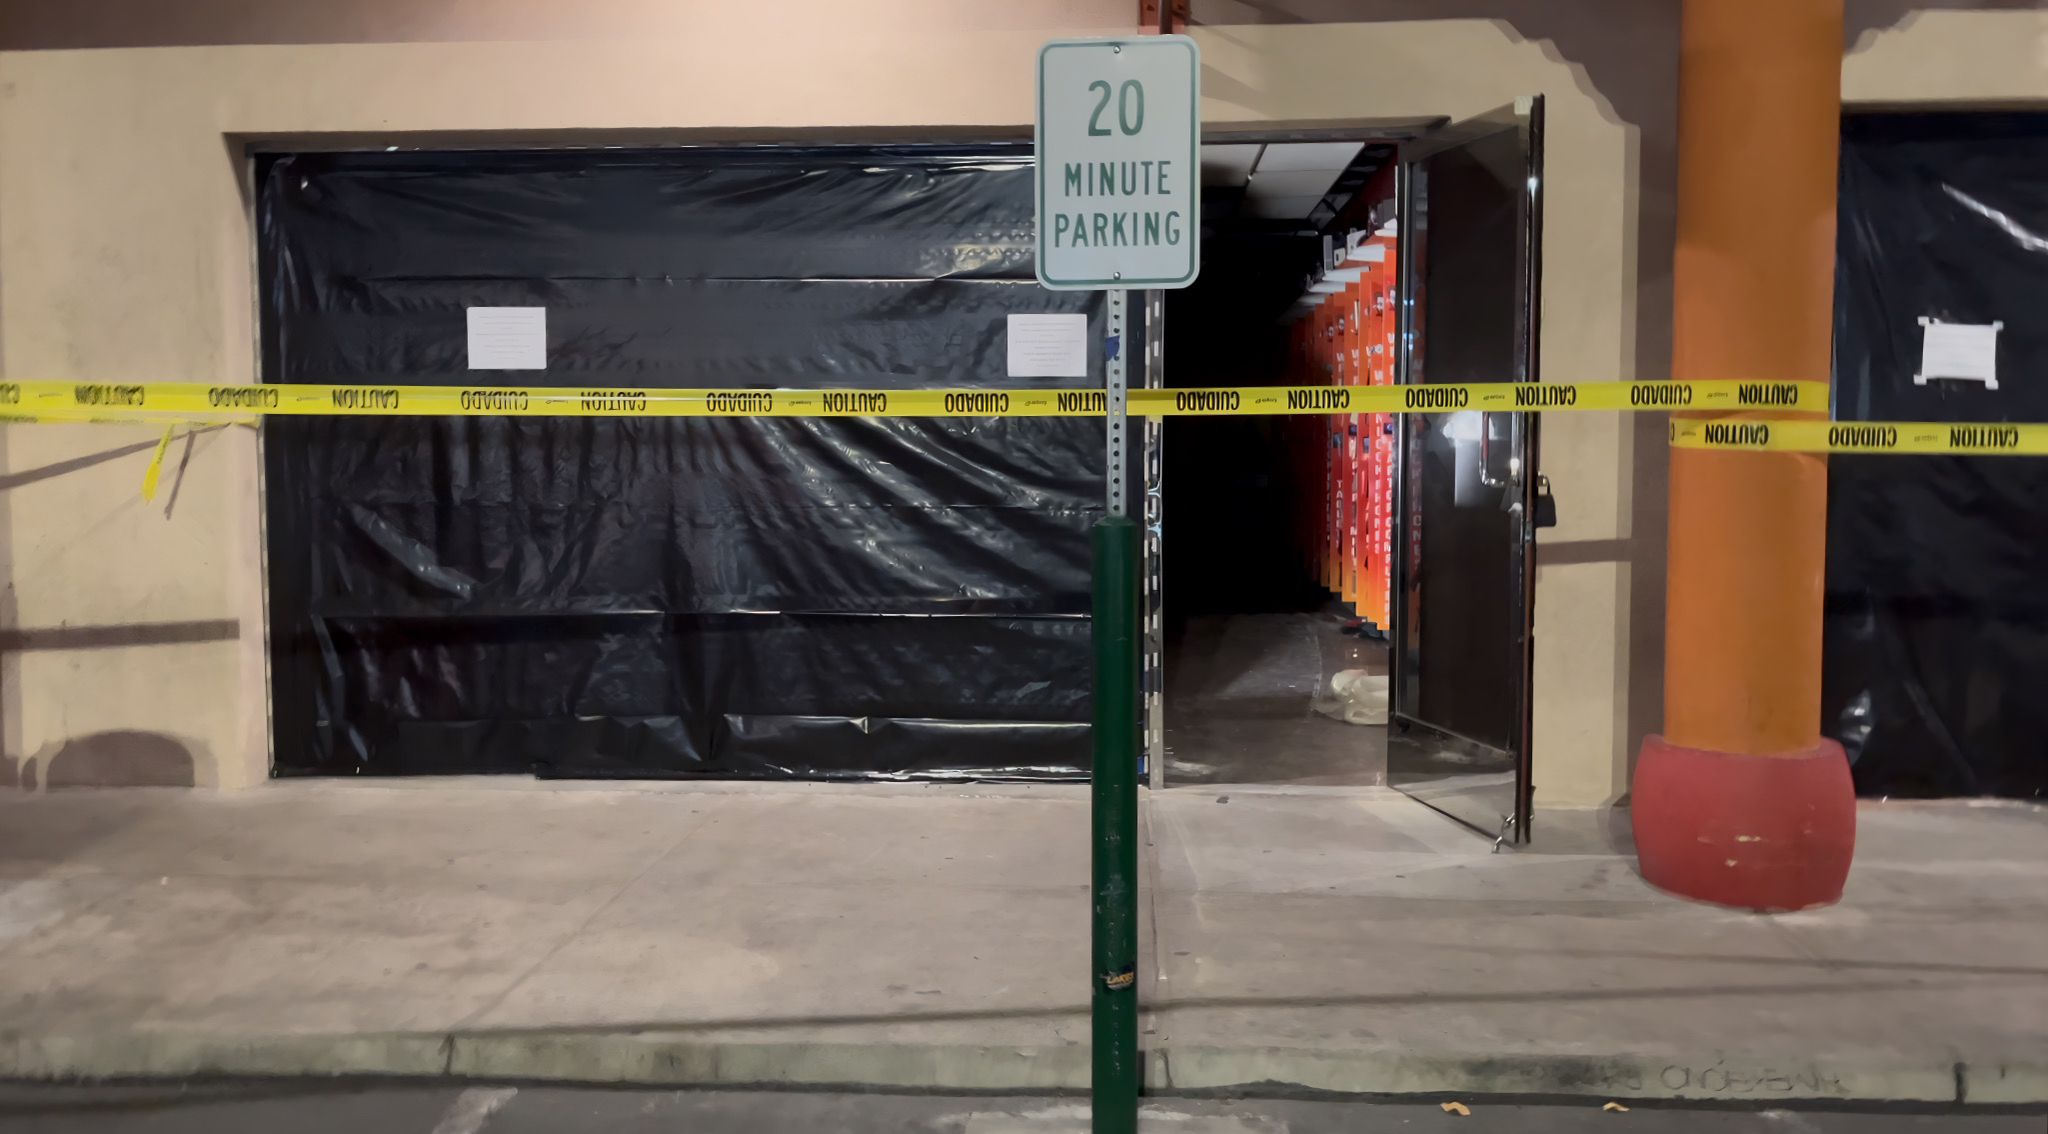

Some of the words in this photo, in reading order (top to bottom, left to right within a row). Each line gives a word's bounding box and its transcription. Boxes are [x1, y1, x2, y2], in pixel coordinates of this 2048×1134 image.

[1088, 79, 1145, 136] 20
[1065, 161, 1171, 196] MINUTE
[1055, 211, 1180, 247] PARKING
[208, 387, 279, 408] CUIDADO
[331, 388, 400, 409] CAUTION
[460, 390, 529, 411] CUIDADO
[580, 391, 647, 411] CAUTION
[706, 392, 773, 412] CUIDADO
[822, 392, 887, 413] CAUTION
[944, 392, 1010, 413] CUIDADO
[1057, 391, 1107, 412] AUTION
[1175, 390, 1240, 411] CUIDADO
[1287, 388, 1350, 410] CAUTION
[1405, 387, 1469, 409] CUIDADO
[1515, 385, 1577, 406] CAUTION
[1630, 384, 1692, 406] CUIDADO
[1738, 384, 1798, 405] CAUTION
[1705, 423, 1769, 445] CAUTION
[1828, 427, 1897, 447] CUIDADO
[1949, 427, 2019, 448] CAUTION
